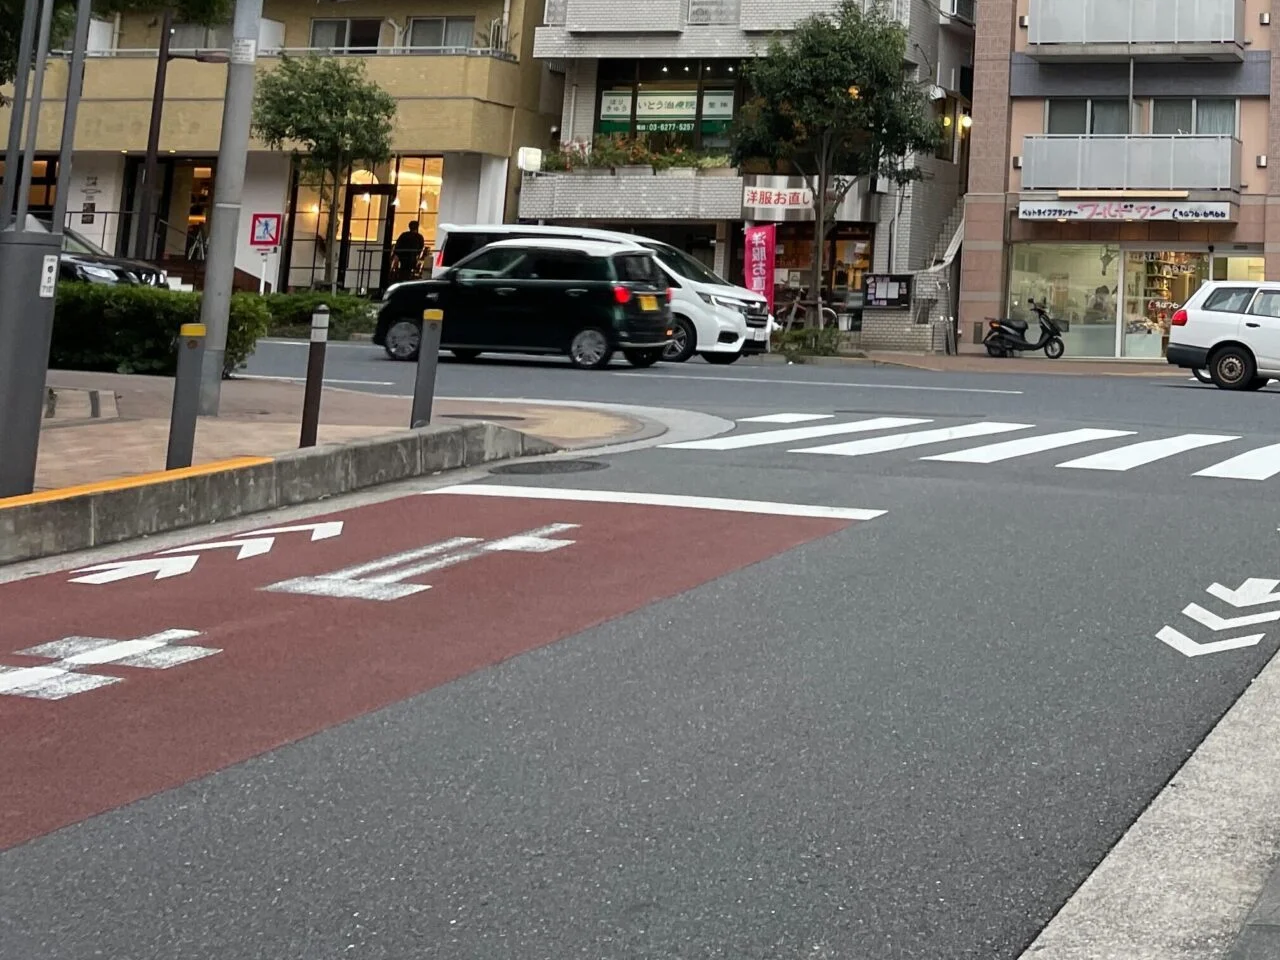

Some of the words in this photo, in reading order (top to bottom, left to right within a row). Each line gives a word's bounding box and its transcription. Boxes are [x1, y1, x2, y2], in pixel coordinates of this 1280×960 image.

[746, 189, 810, 205] 洋服お直し
